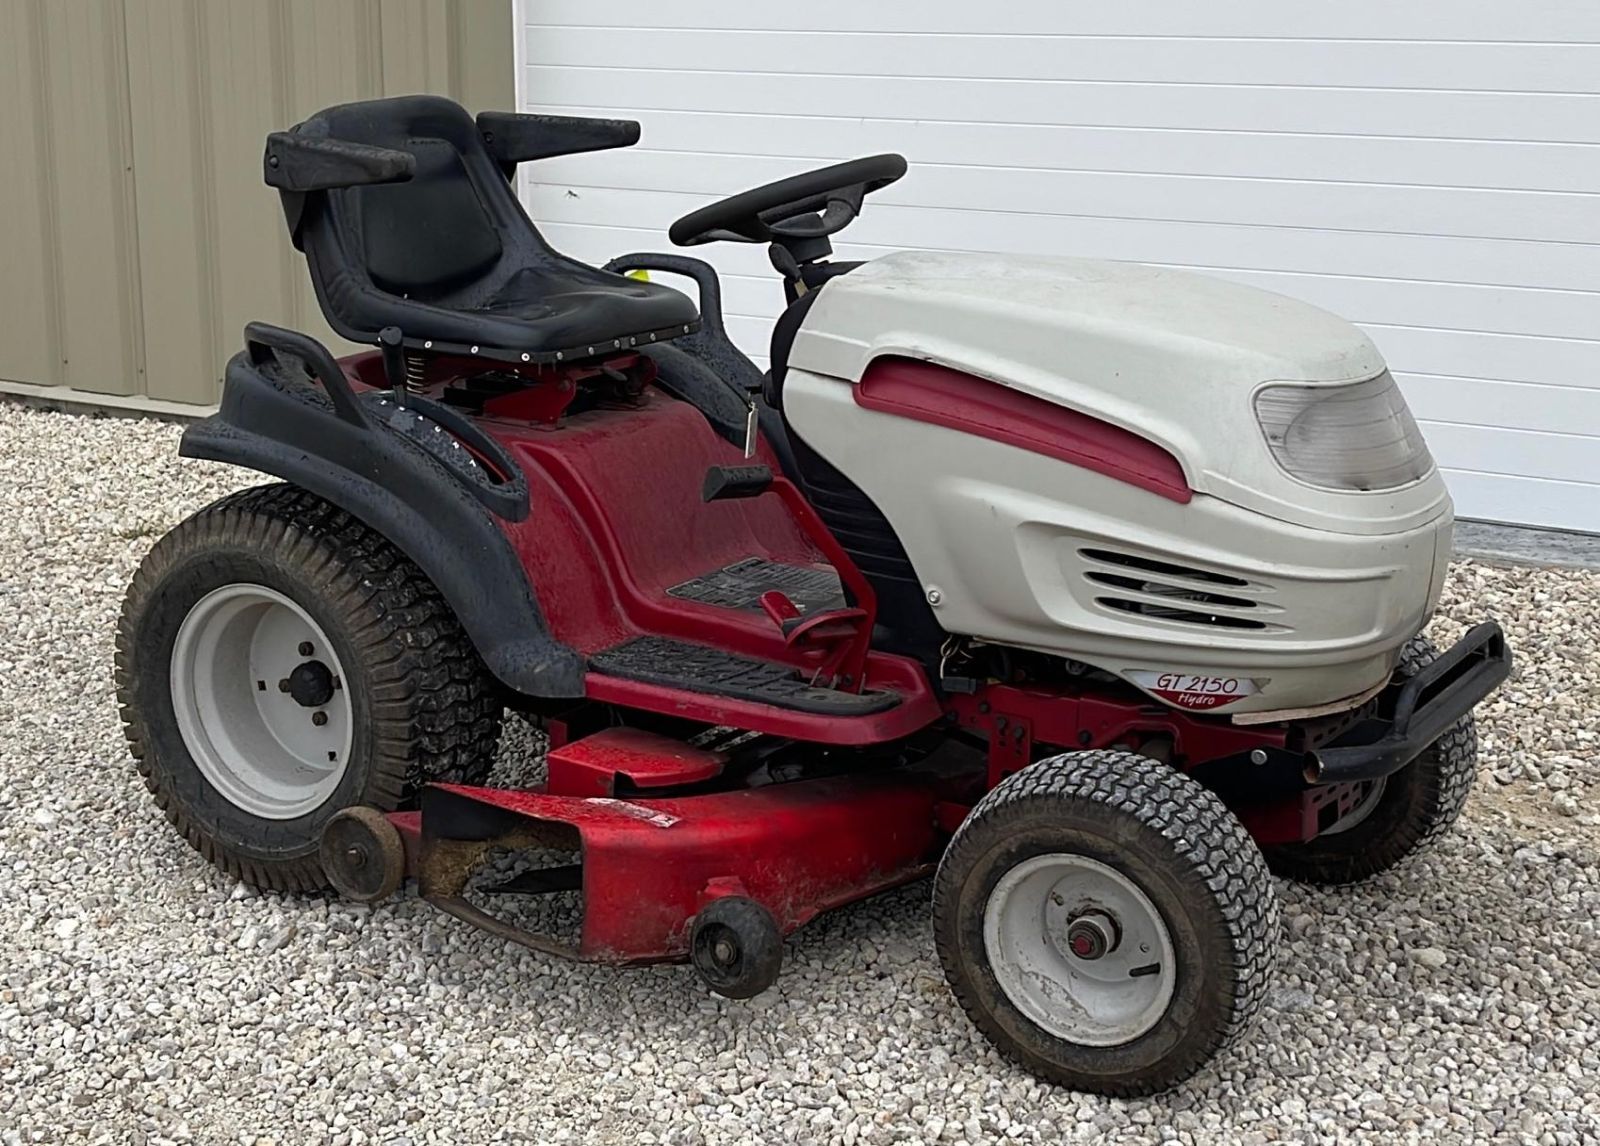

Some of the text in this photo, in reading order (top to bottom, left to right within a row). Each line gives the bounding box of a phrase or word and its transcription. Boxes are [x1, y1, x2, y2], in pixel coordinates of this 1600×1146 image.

[1157, 673, 1238, 694] GT 2150
[1178, 694, 1215, 706] Hydro
